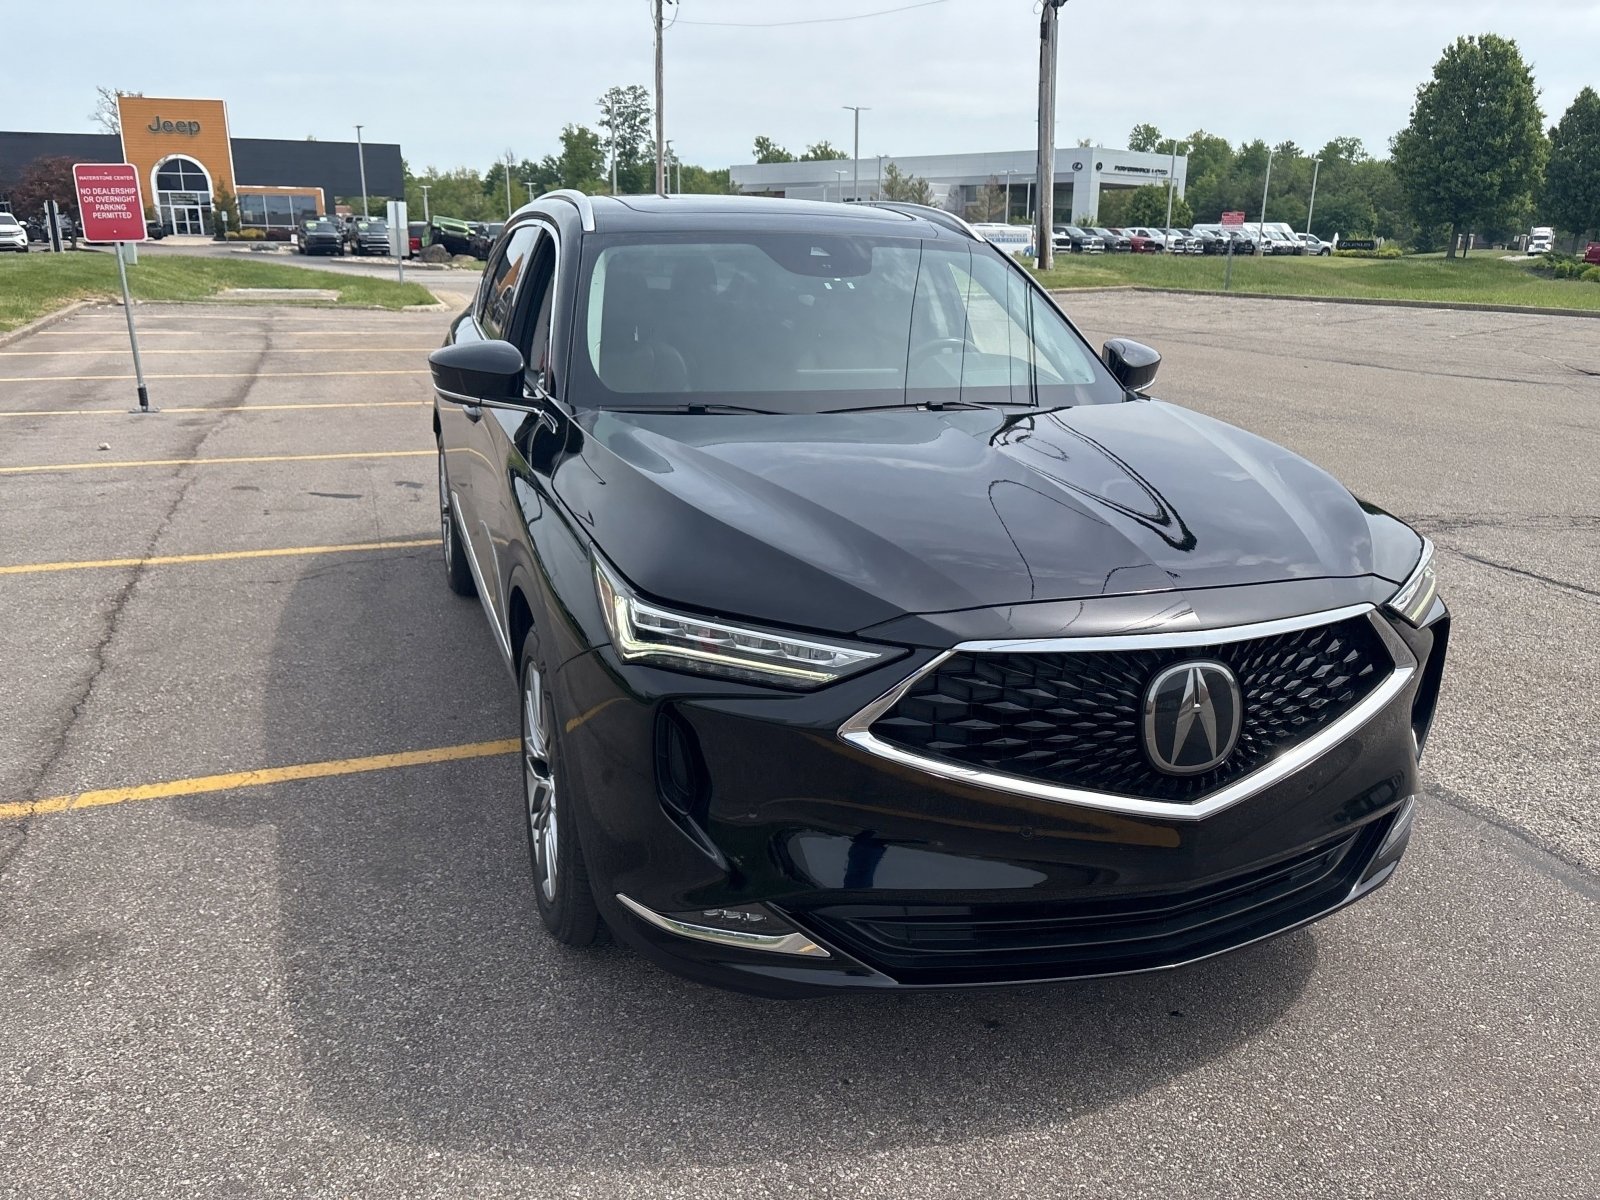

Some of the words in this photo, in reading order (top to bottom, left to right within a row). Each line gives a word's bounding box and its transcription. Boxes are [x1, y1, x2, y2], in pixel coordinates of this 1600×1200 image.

[147, 115, 201, 135] Jeep
[80, 187, 91, 195] NO
[92, 187, 136, 195] DEALERSHIP
[83, 195, 94, 203] OR
[95, 195, 136, 203] OVERNIGHT
[95, 203, 127, 211] PARKING
[92, 211, 132, 219] PERMITTED
